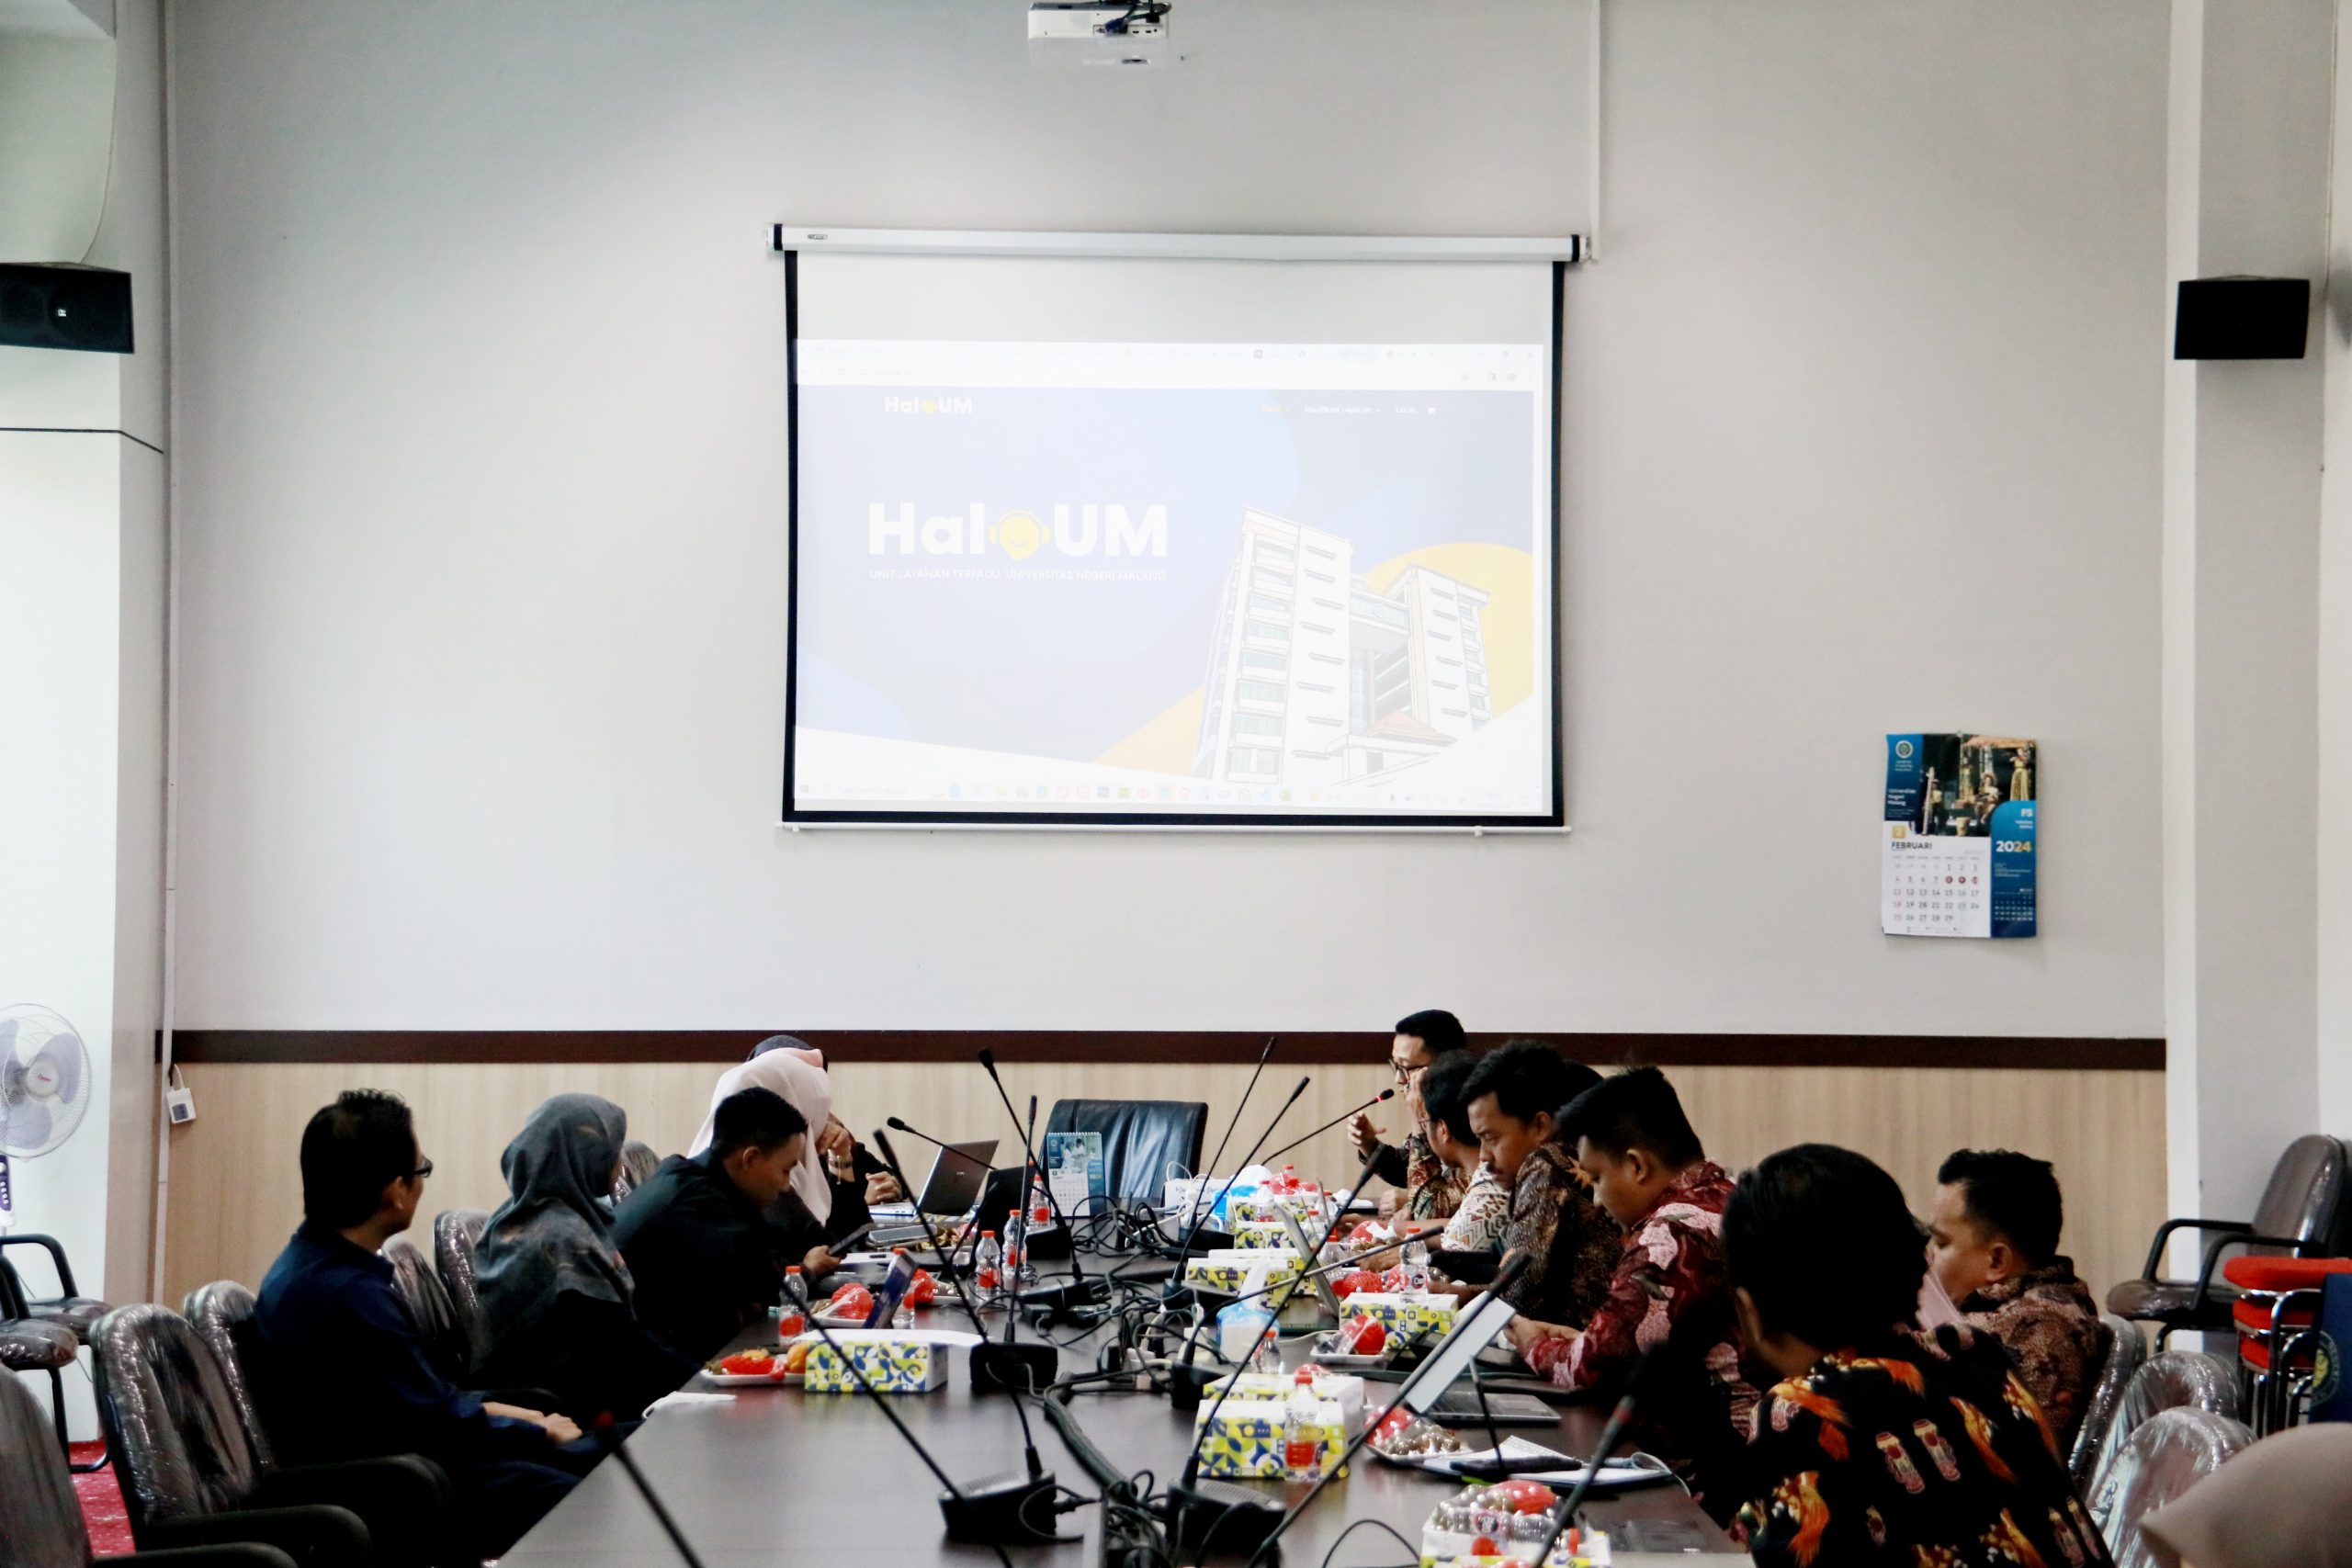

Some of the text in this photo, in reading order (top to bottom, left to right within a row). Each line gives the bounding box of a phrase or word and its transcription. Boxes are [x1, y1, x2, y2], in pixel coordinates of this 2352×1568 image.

[869, 568, 897, 580] UNIT
[899, 568, 949, 580] LAYANAN
[952, 568, 1001, 581] TERPADU
[1118, 570, 1167, 581] MALANG
[1891, 841, 1932, 850] FEBRUARI
[1996, 840, 2031, 852] 2024
